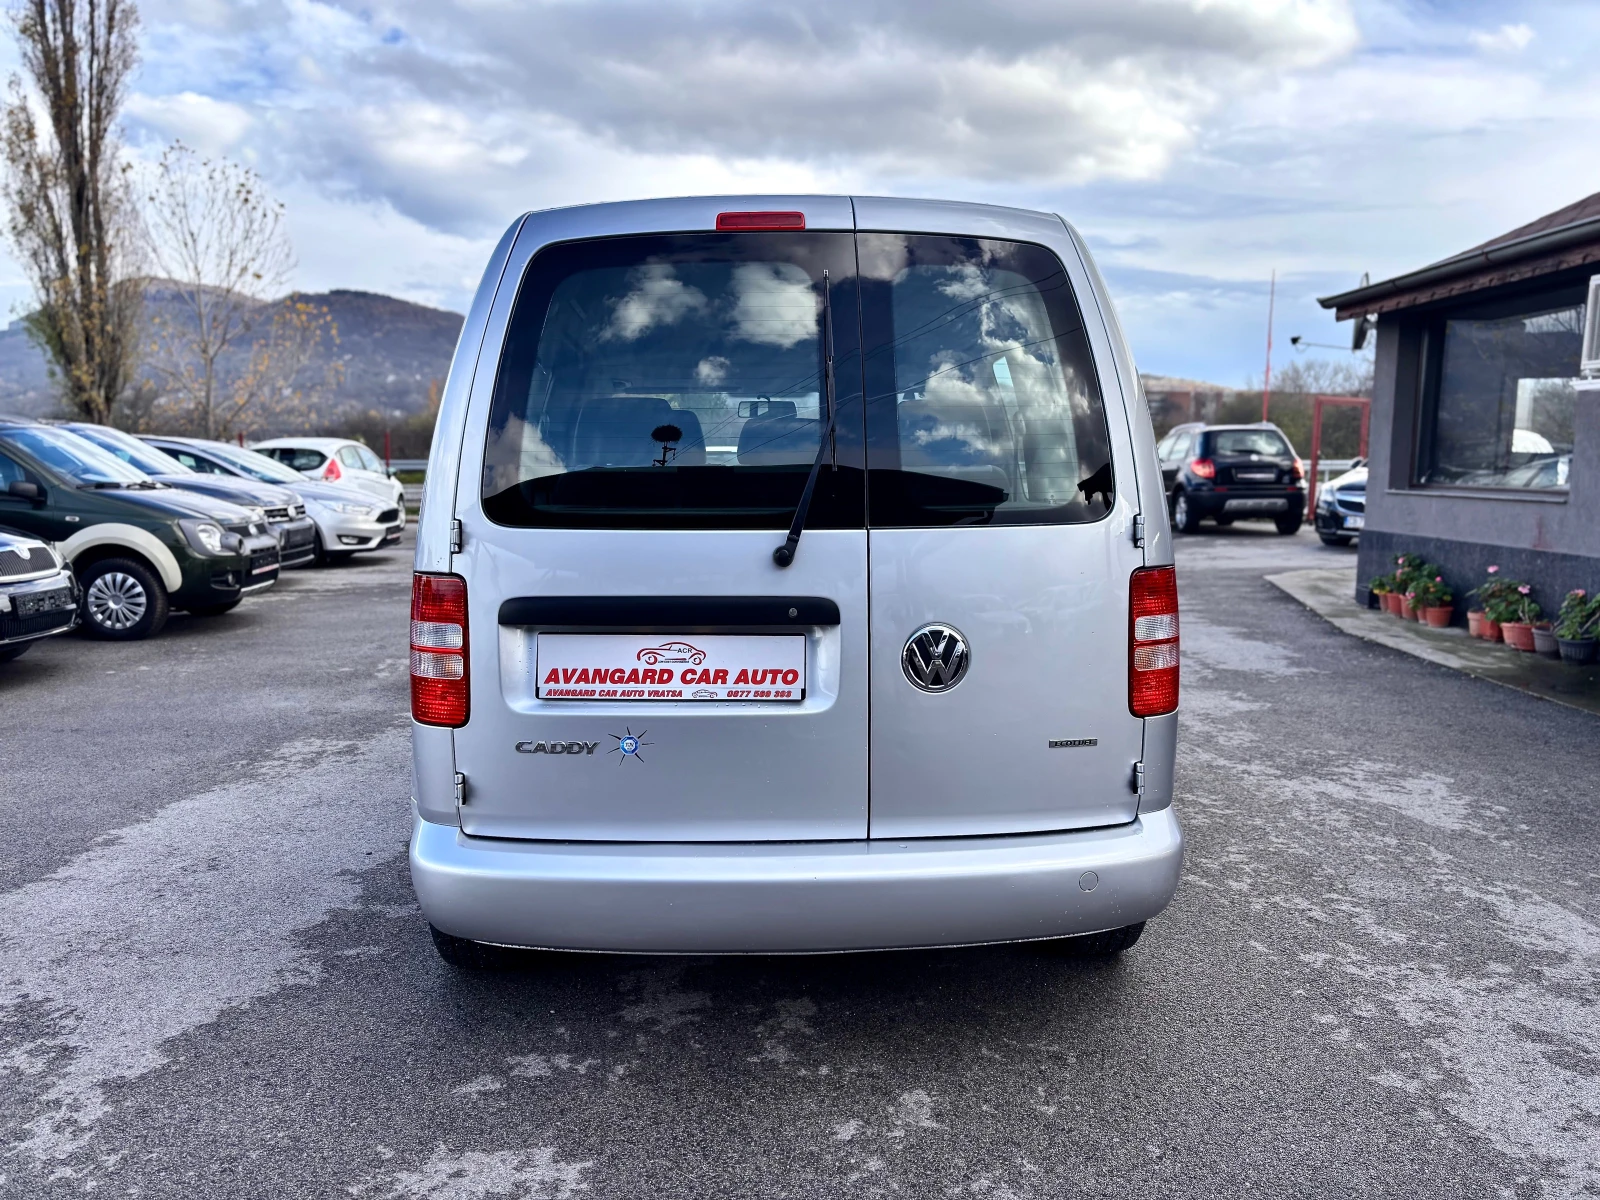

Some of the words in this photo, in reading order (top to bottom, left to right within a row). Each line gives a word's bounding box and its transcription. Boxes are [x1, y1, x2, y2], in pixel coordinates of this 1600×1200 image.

[543, 668, 674, 685] AVANGARD
[680, 668, 729, 685] CAR
[733, 669, 799, 686] AUTO
[545, 688, 596, 697] AVANGARD
[598, 689, 618, 697] CAR
[619, 689, 645, 697] AUTO
[647, 689, 683, 698] VRATSA
[726, 690, 751, 698] 0877
[515, 740, 601, 755] CADDY
